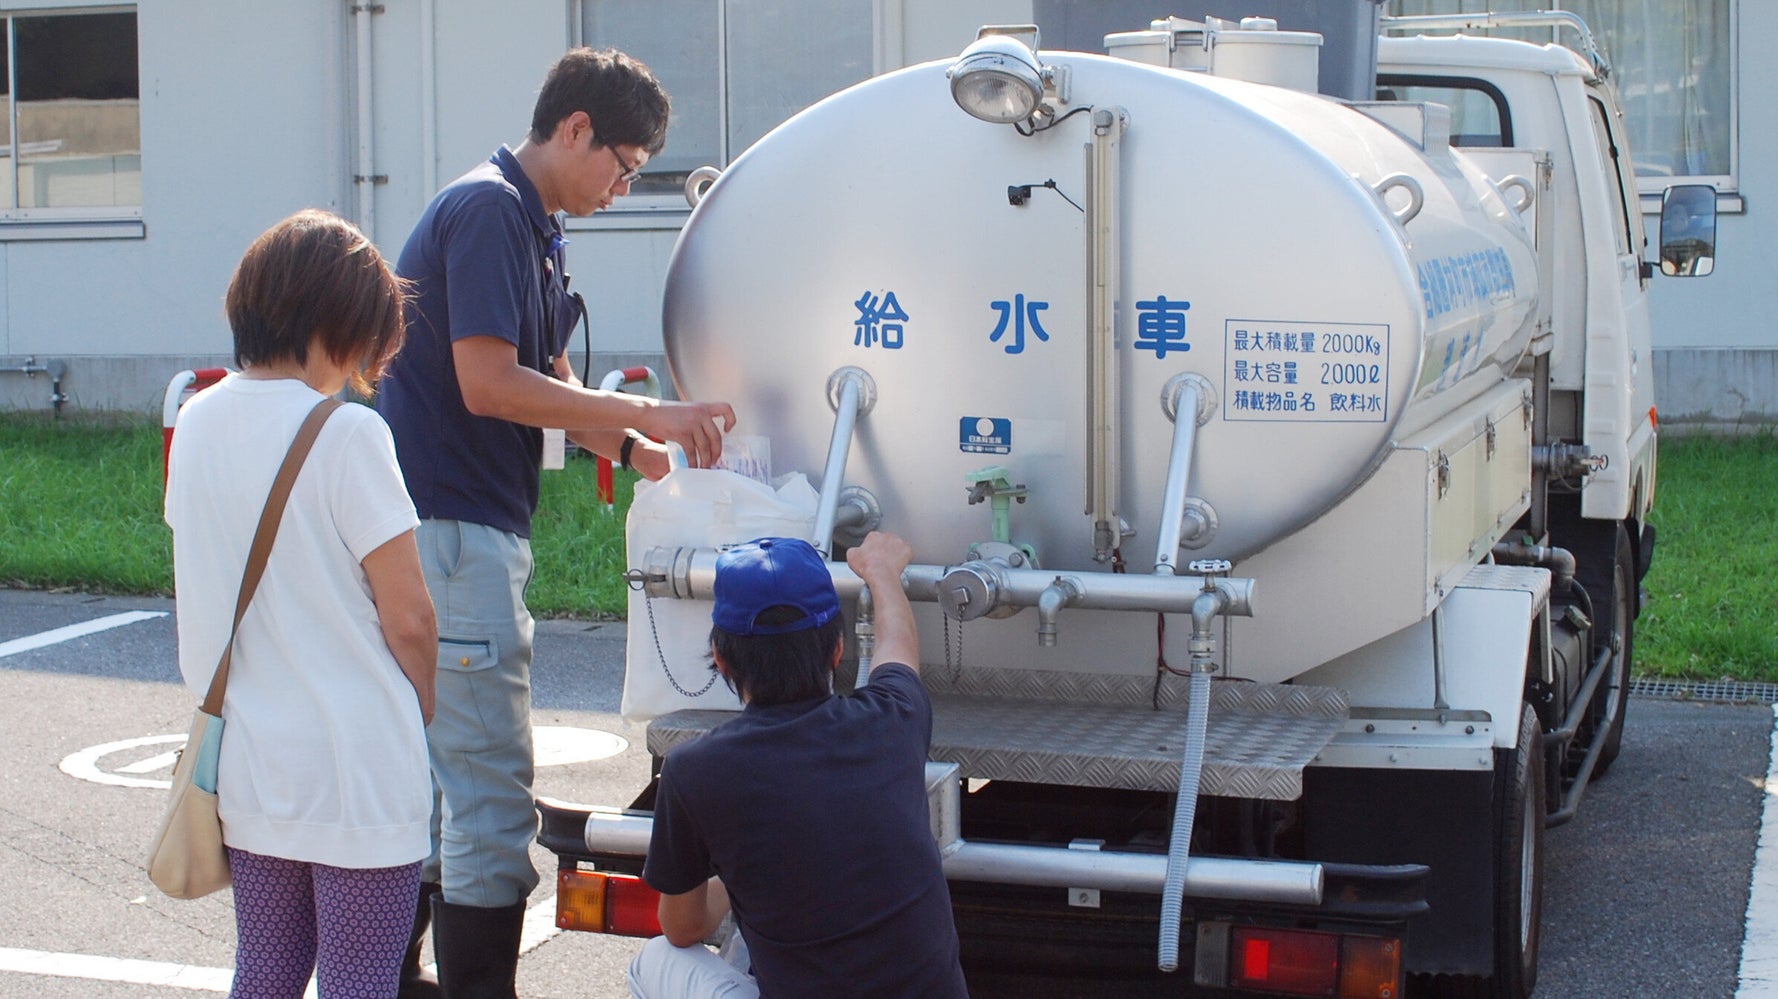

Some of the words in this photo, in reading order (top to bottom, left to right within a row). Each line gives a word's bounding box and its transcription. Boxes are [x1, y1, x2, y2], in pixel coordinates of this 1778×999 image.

[854, 290, 1192, 360] 給水車
[1234, 330, 1316, 353] 最大積載量
[1234, 360, 1298, 385] 最大容量
[1233, 390, 1316, 412] 積載物品名
[1330, 393, 1382, 412] 飲料水
